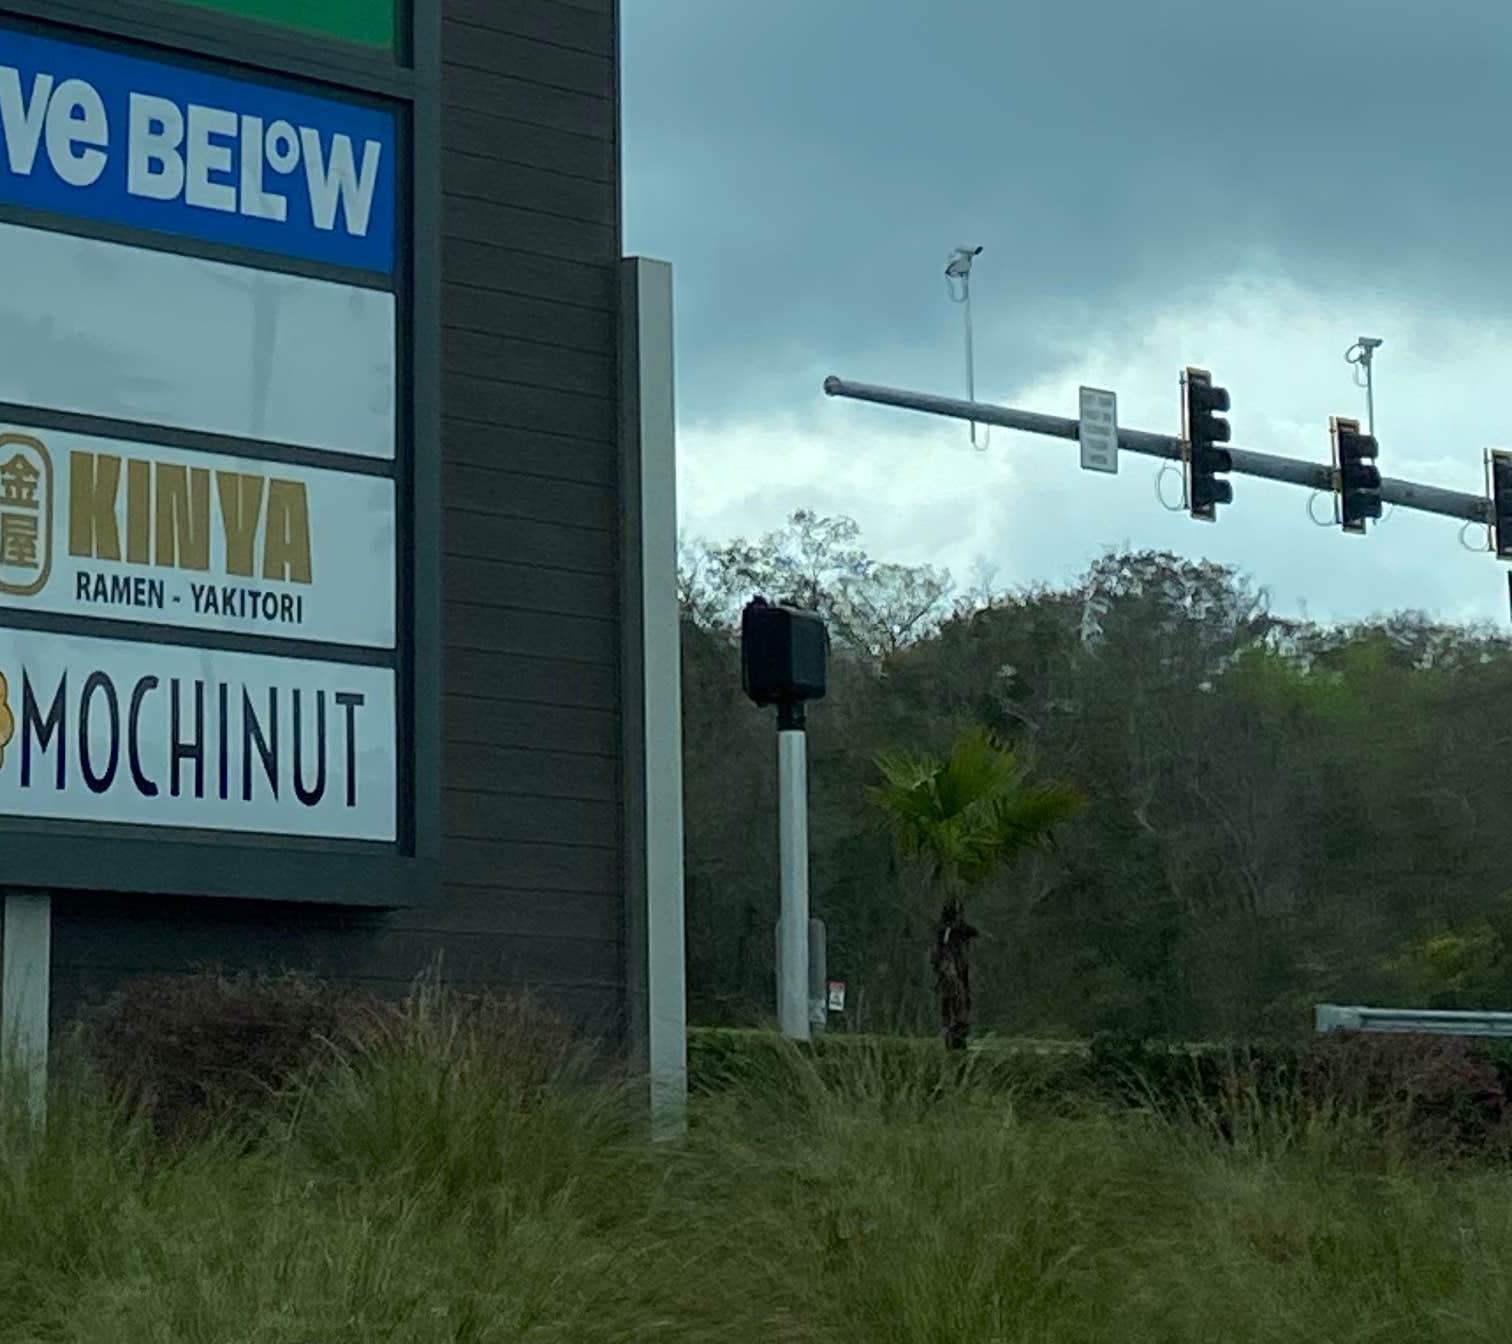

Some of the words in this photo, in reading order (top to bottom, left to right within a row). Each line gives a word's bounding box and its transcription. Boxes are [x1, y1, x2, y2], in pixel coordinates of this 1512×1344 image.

[127, 91, 381, 237] BELOW
[68, 450, 313, 585] KINYA
[76, 570, 165, 610] RAMEN
[190, 582, 304, 625] YAKITORI
[20, 664, 364, 807] MOCHINUT
